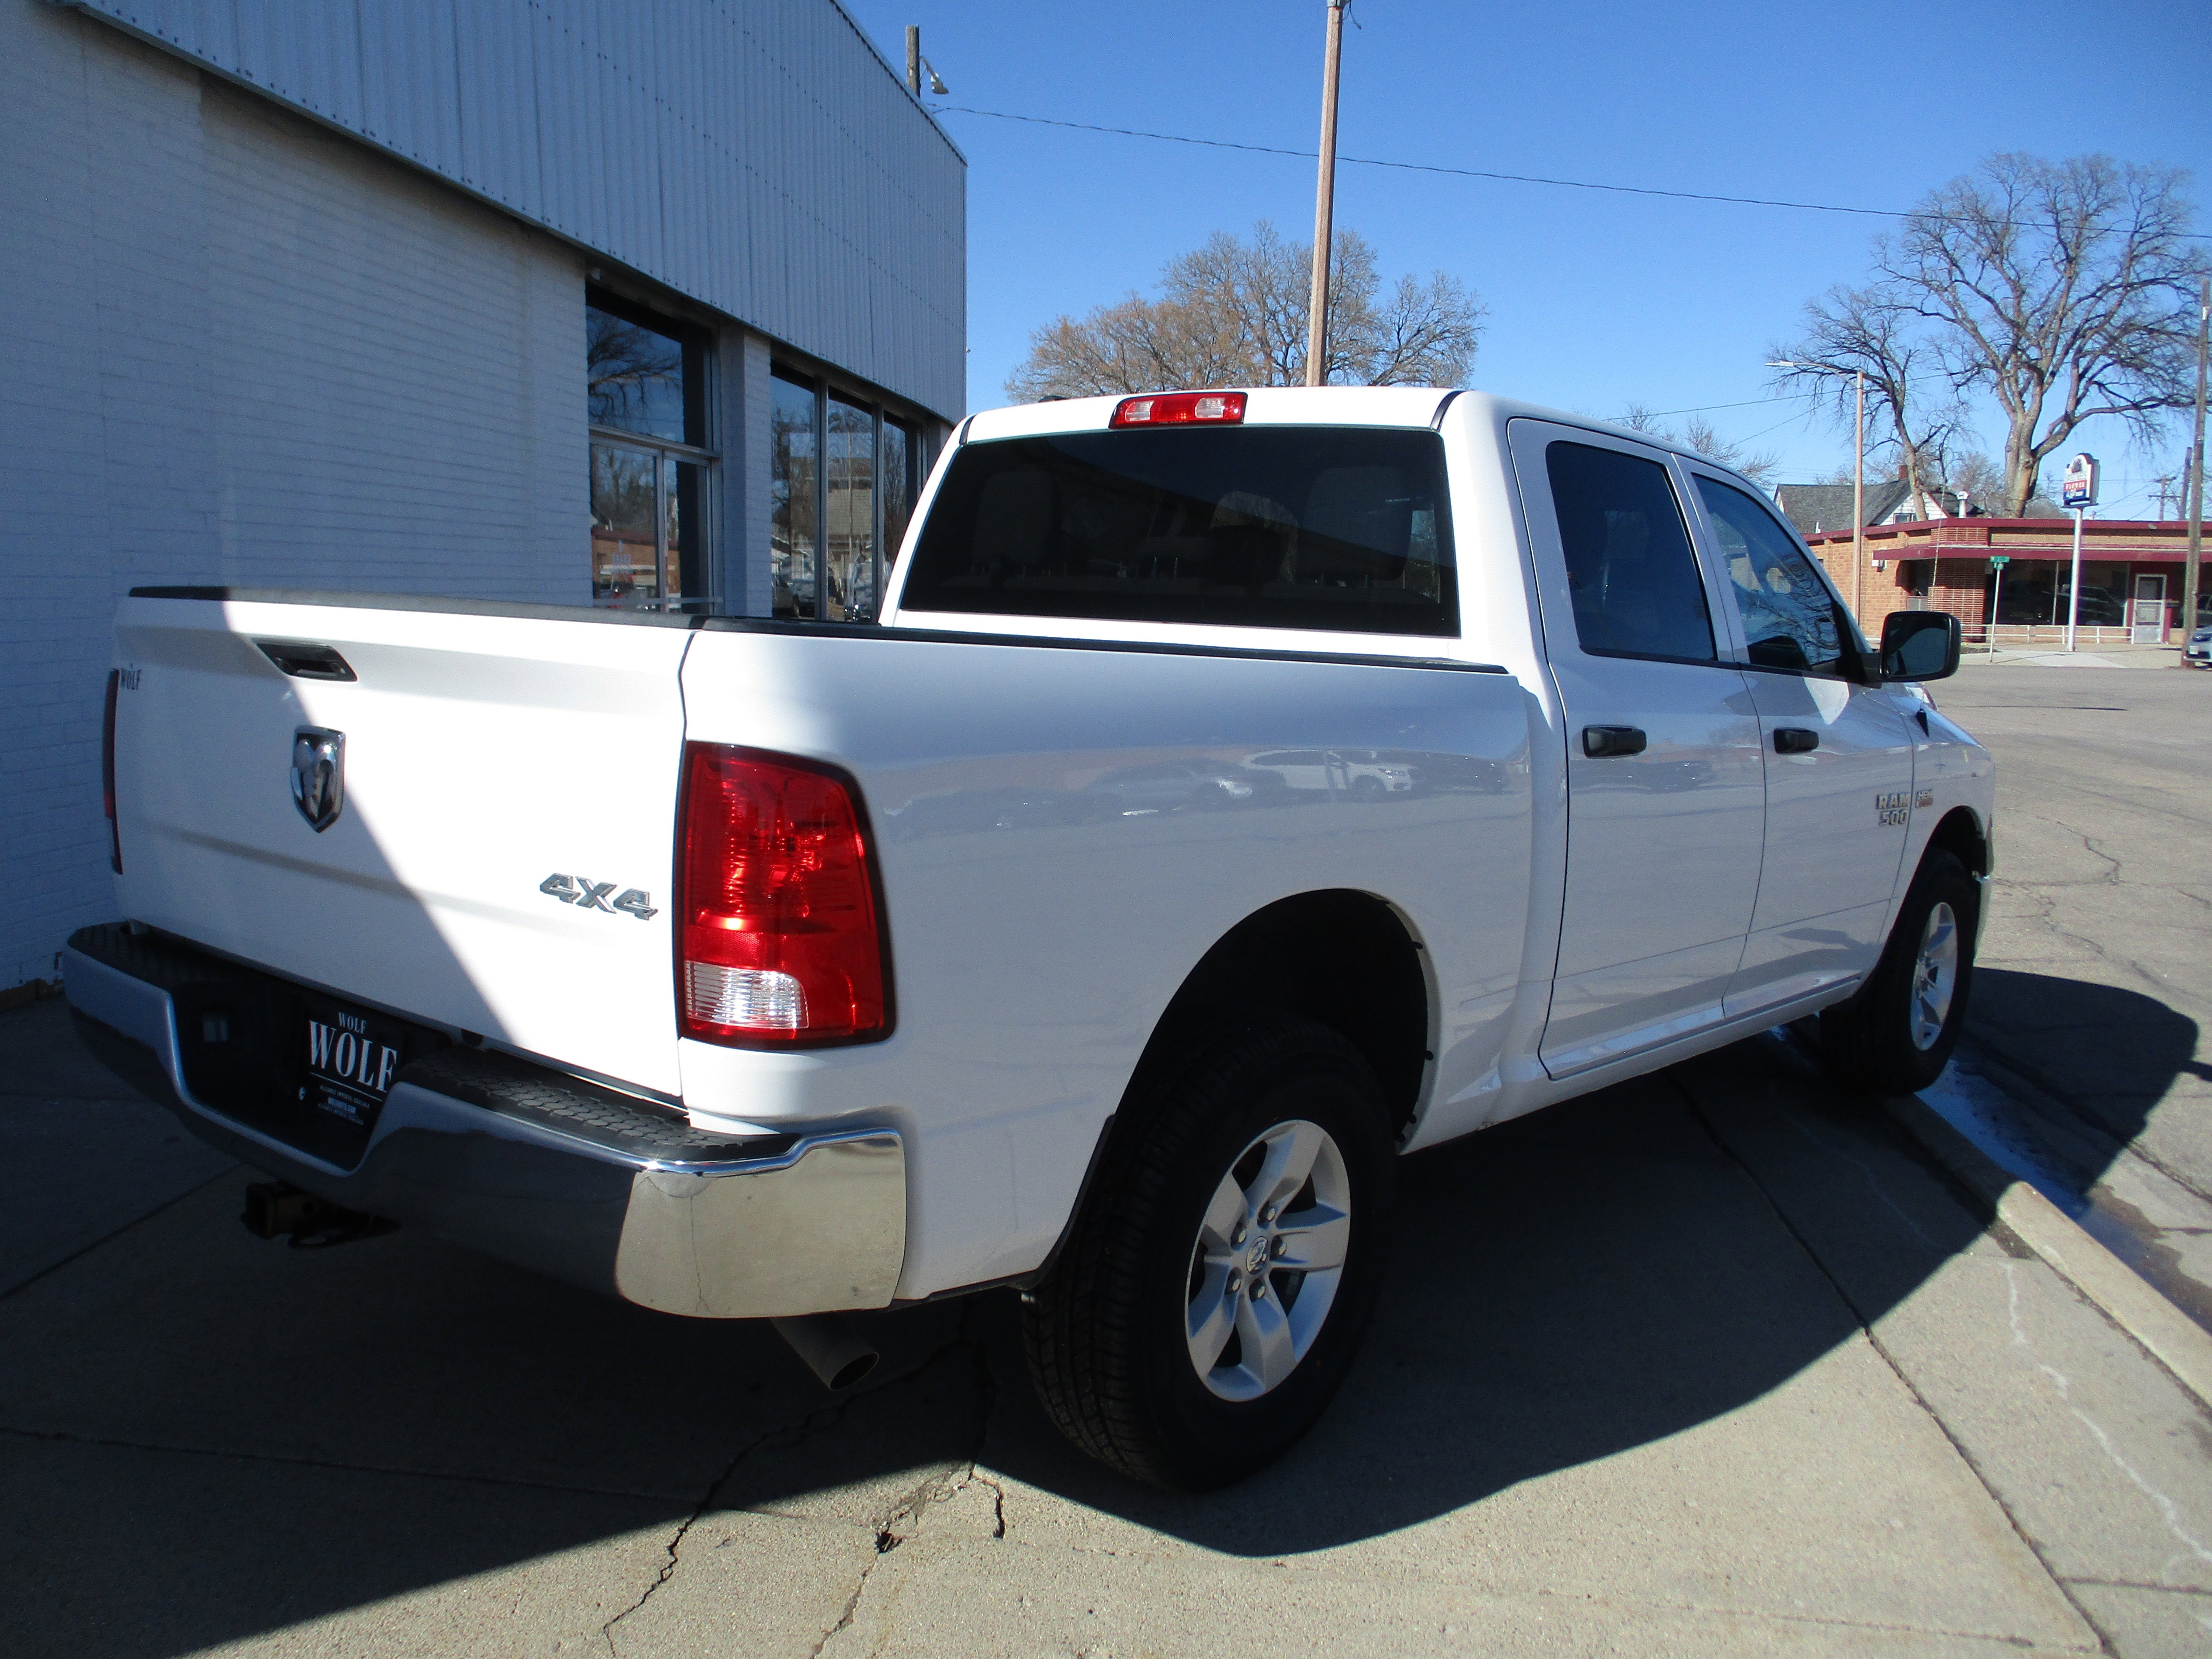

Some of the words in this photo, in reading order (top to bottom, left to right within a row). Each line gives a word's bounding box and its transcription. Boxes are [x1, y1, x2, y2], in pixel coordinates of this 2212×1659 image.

[1876, 792, 1909, 809] RAM
[339, 1012, 367, 1034] WOLF
[310, 1020, 397, 1093] WOLF
